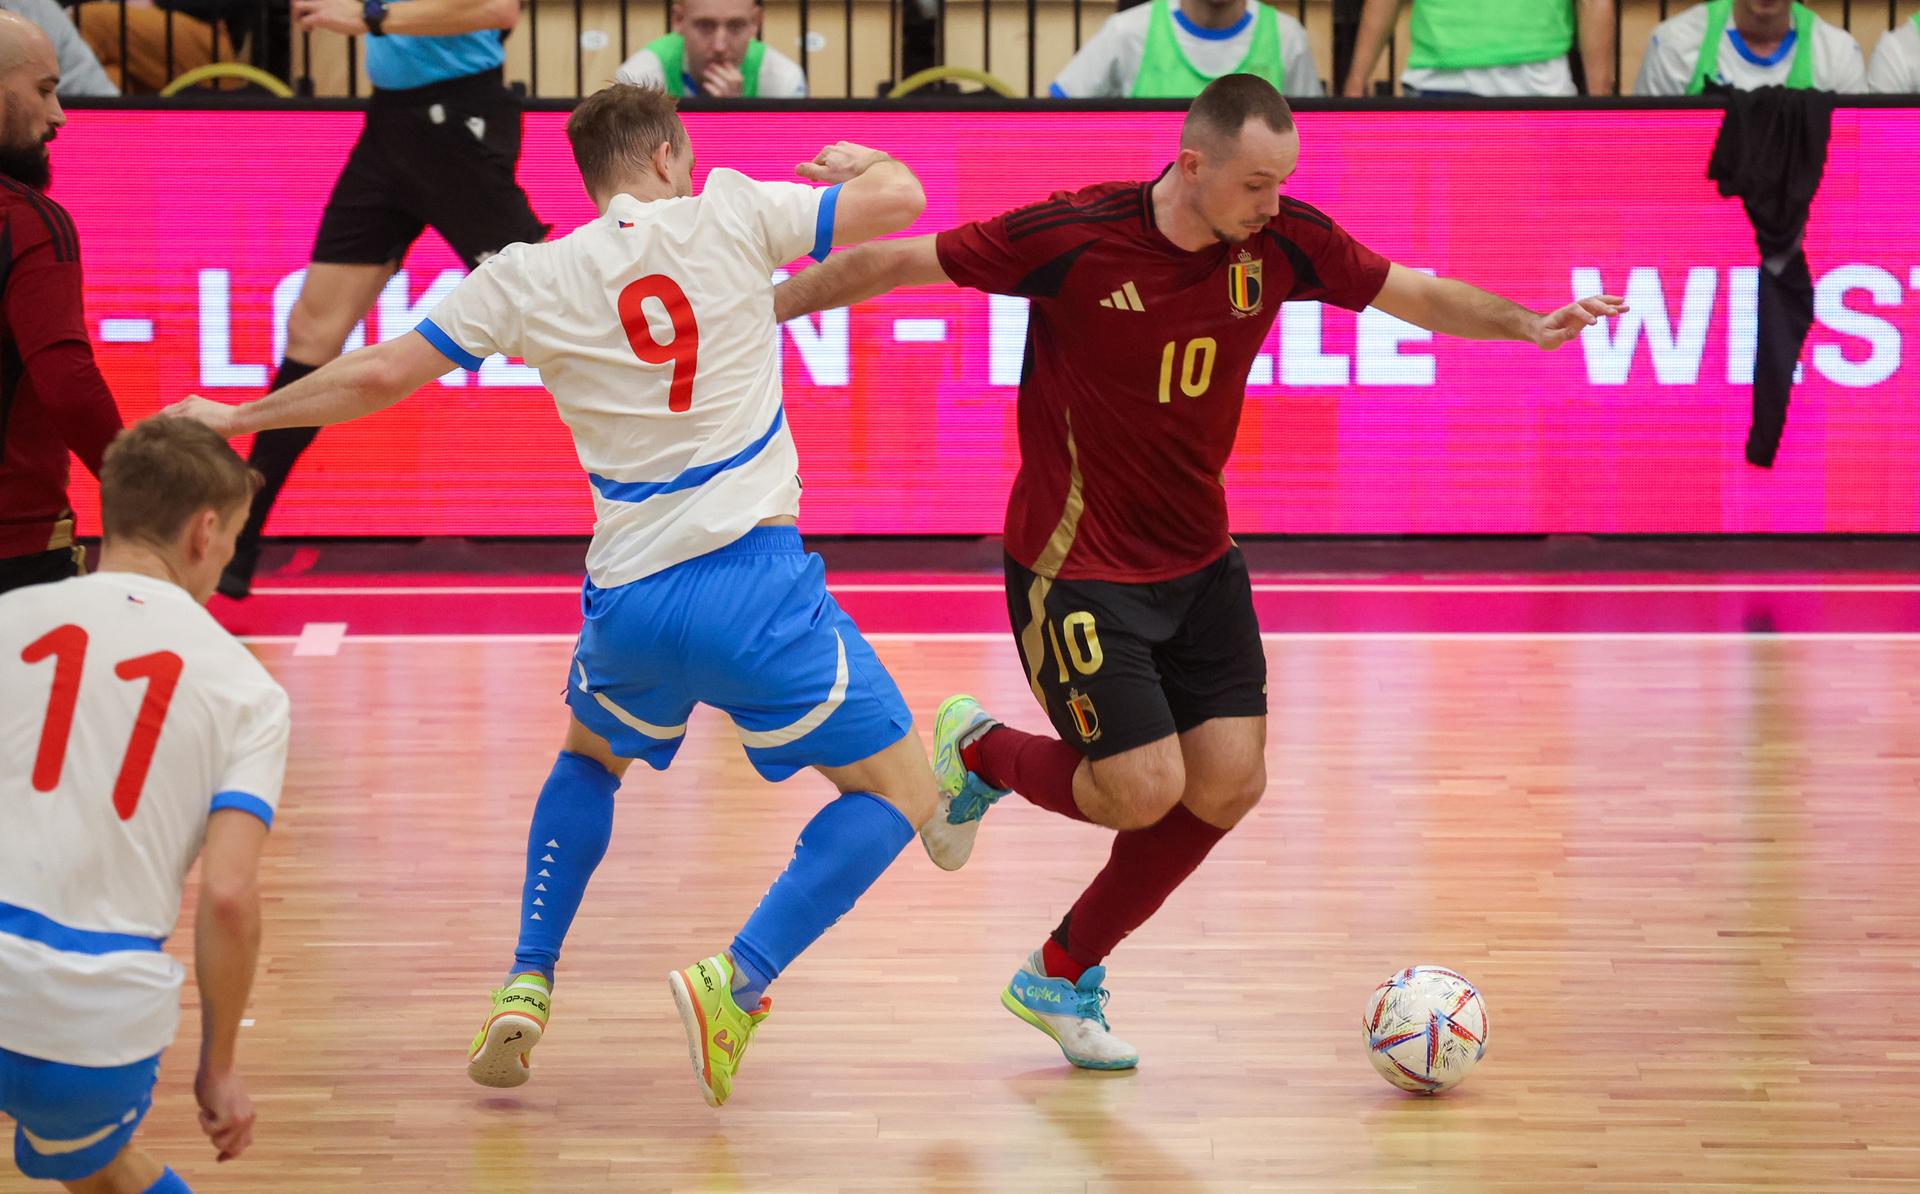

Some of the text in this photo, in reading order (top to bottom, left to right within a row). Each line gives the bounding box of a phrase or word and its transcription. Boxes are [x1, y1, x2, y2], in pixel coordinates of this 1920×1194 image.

[618, 274, 699, 413] 9
[1158, 336, 1218, 404] 10
[1048, 610, 1104, 684] 10
[20, 623, 184, 821] 11
